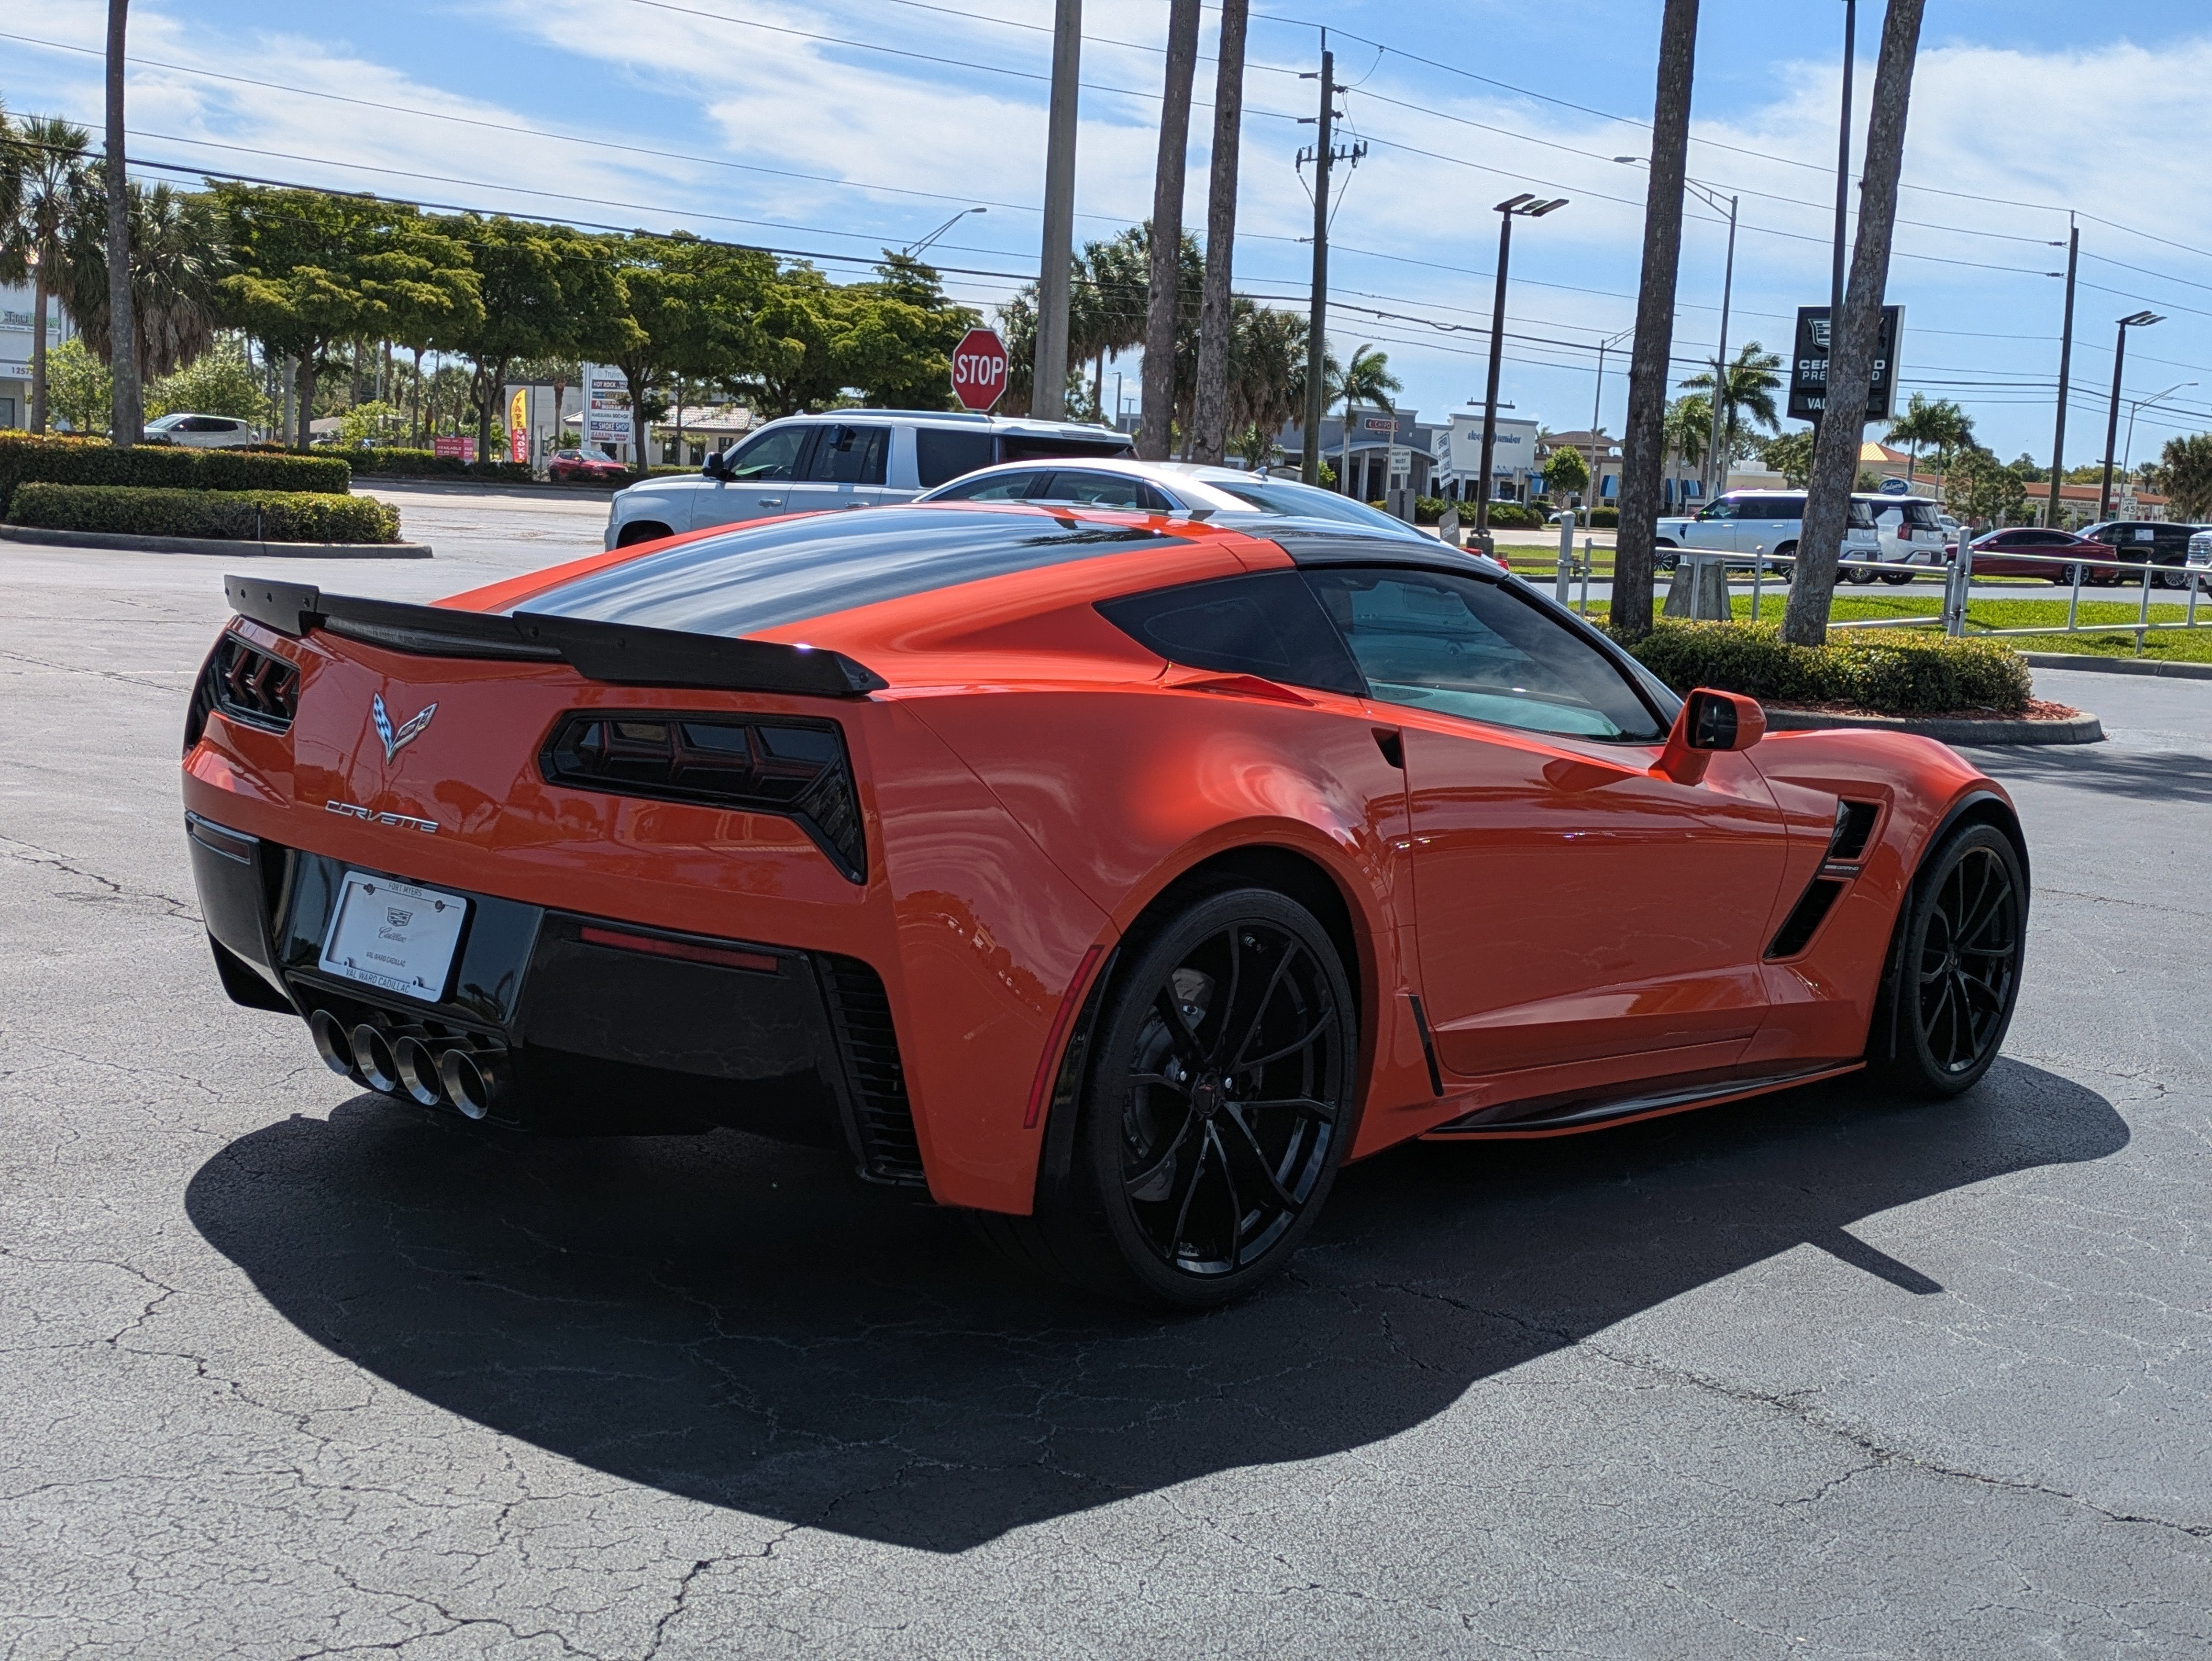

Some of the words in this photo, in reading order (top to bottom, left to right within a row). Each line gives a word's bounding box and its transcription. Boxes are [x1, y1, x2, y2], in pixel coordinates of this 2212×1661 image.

[6, 311, 59, 326] Trulive
[956, 354, 1004, 385] STOP
[598, 422, 615, 430] SMOKE
[516, 429, 526, 461] SMOKE
[1497, 433, 1521, 444] number
[325, 800, 439, 833] CORVETTE
[388, 882, 402, 892] FORT
[403, 886, 422, 897] MYERS
[378, 926, 407, 942] Cadillac
[374, 953, 387, 962] WARD
[387, 956, 406, 967] CADILLAC
[346, 968, 357, 978] VAL
[358, 971, 377, 984] WARD
[378, 977, 410, 993] CADILLAC
